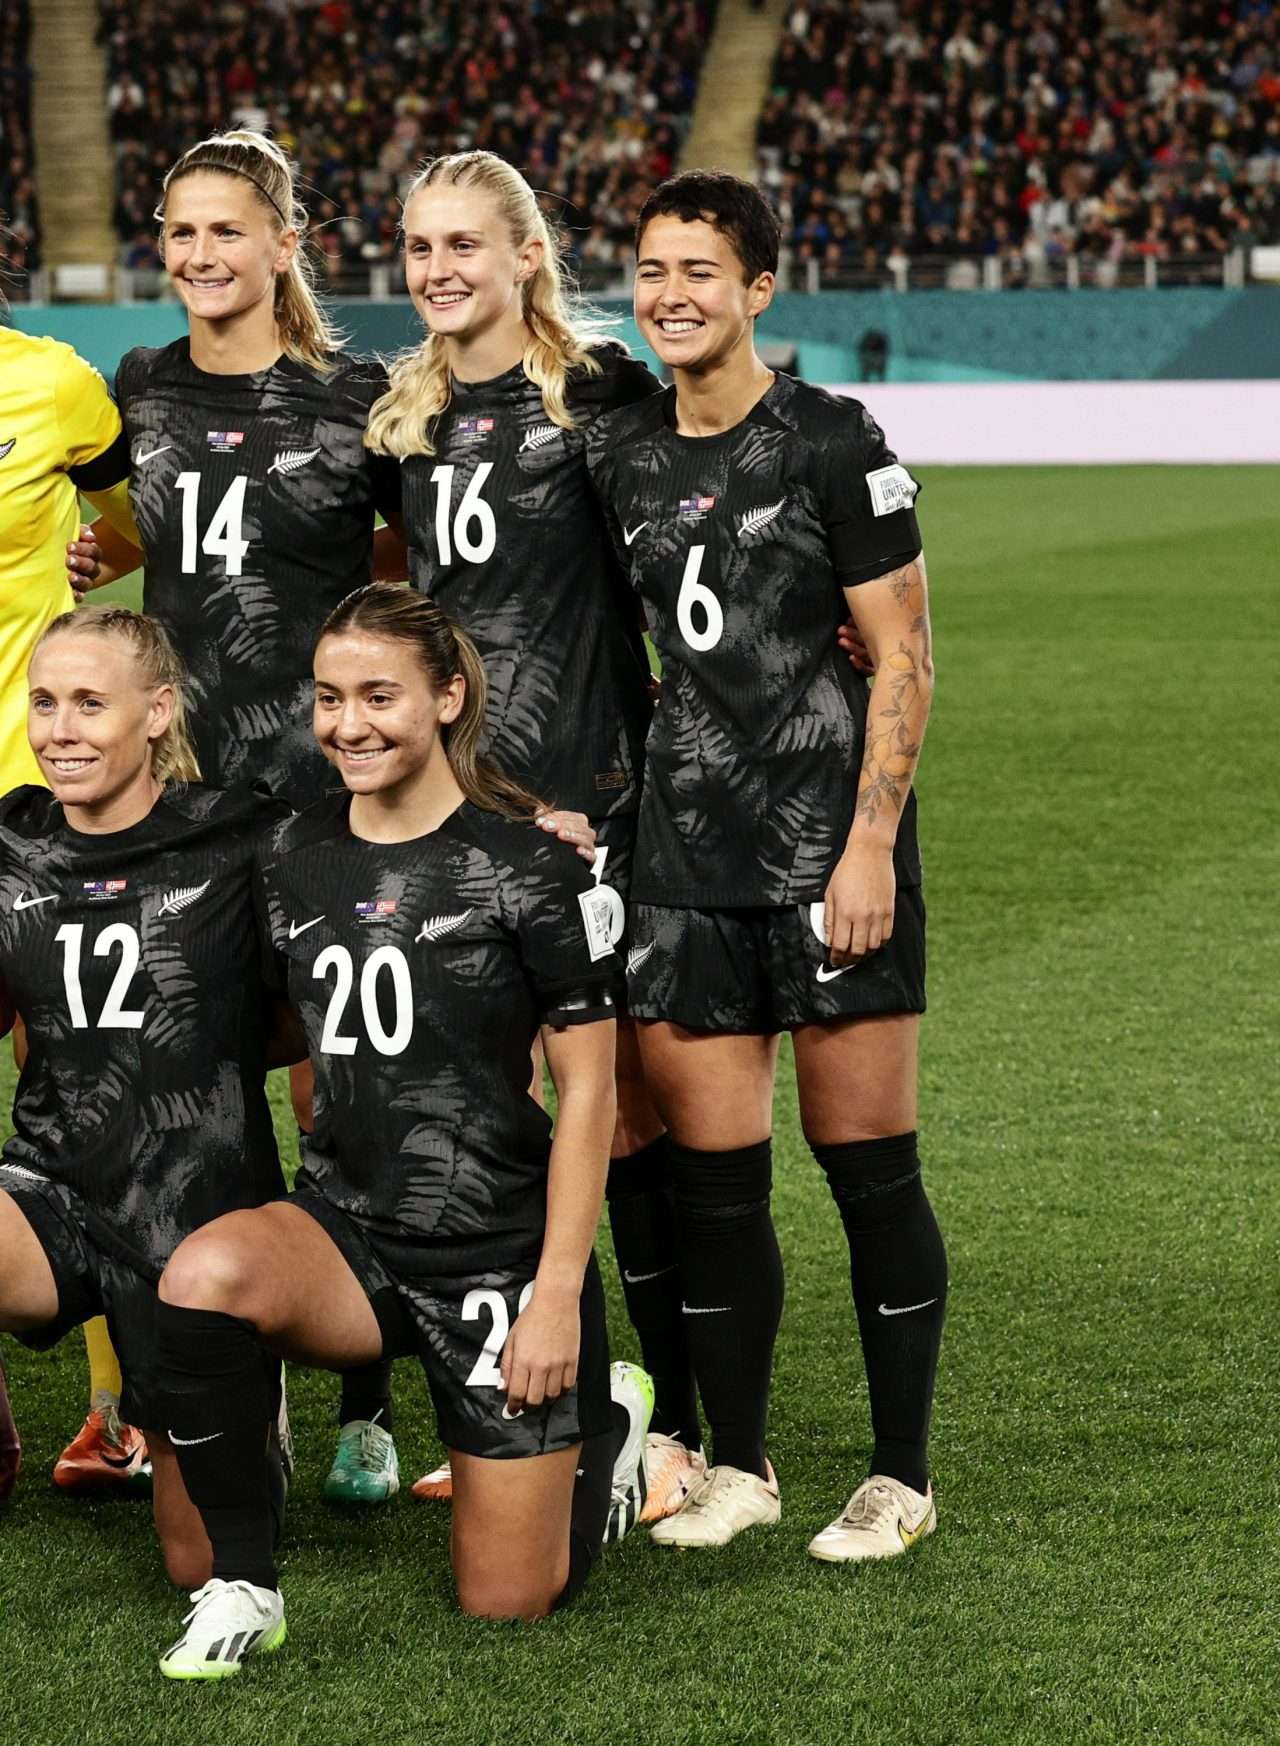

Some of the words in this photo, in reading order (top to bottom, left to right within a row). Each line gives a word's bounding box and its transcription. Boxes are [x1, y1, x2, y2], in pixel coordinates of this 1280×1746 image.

[175, 471, 249, 575] 14
[430, 462, 496, 566] 16
[677, 545, 723, 651] 6
[55, 923, 145, 1029] 12
[313, 945, 413, 1056] 20
[461, 1280, 536, 1387] 2
